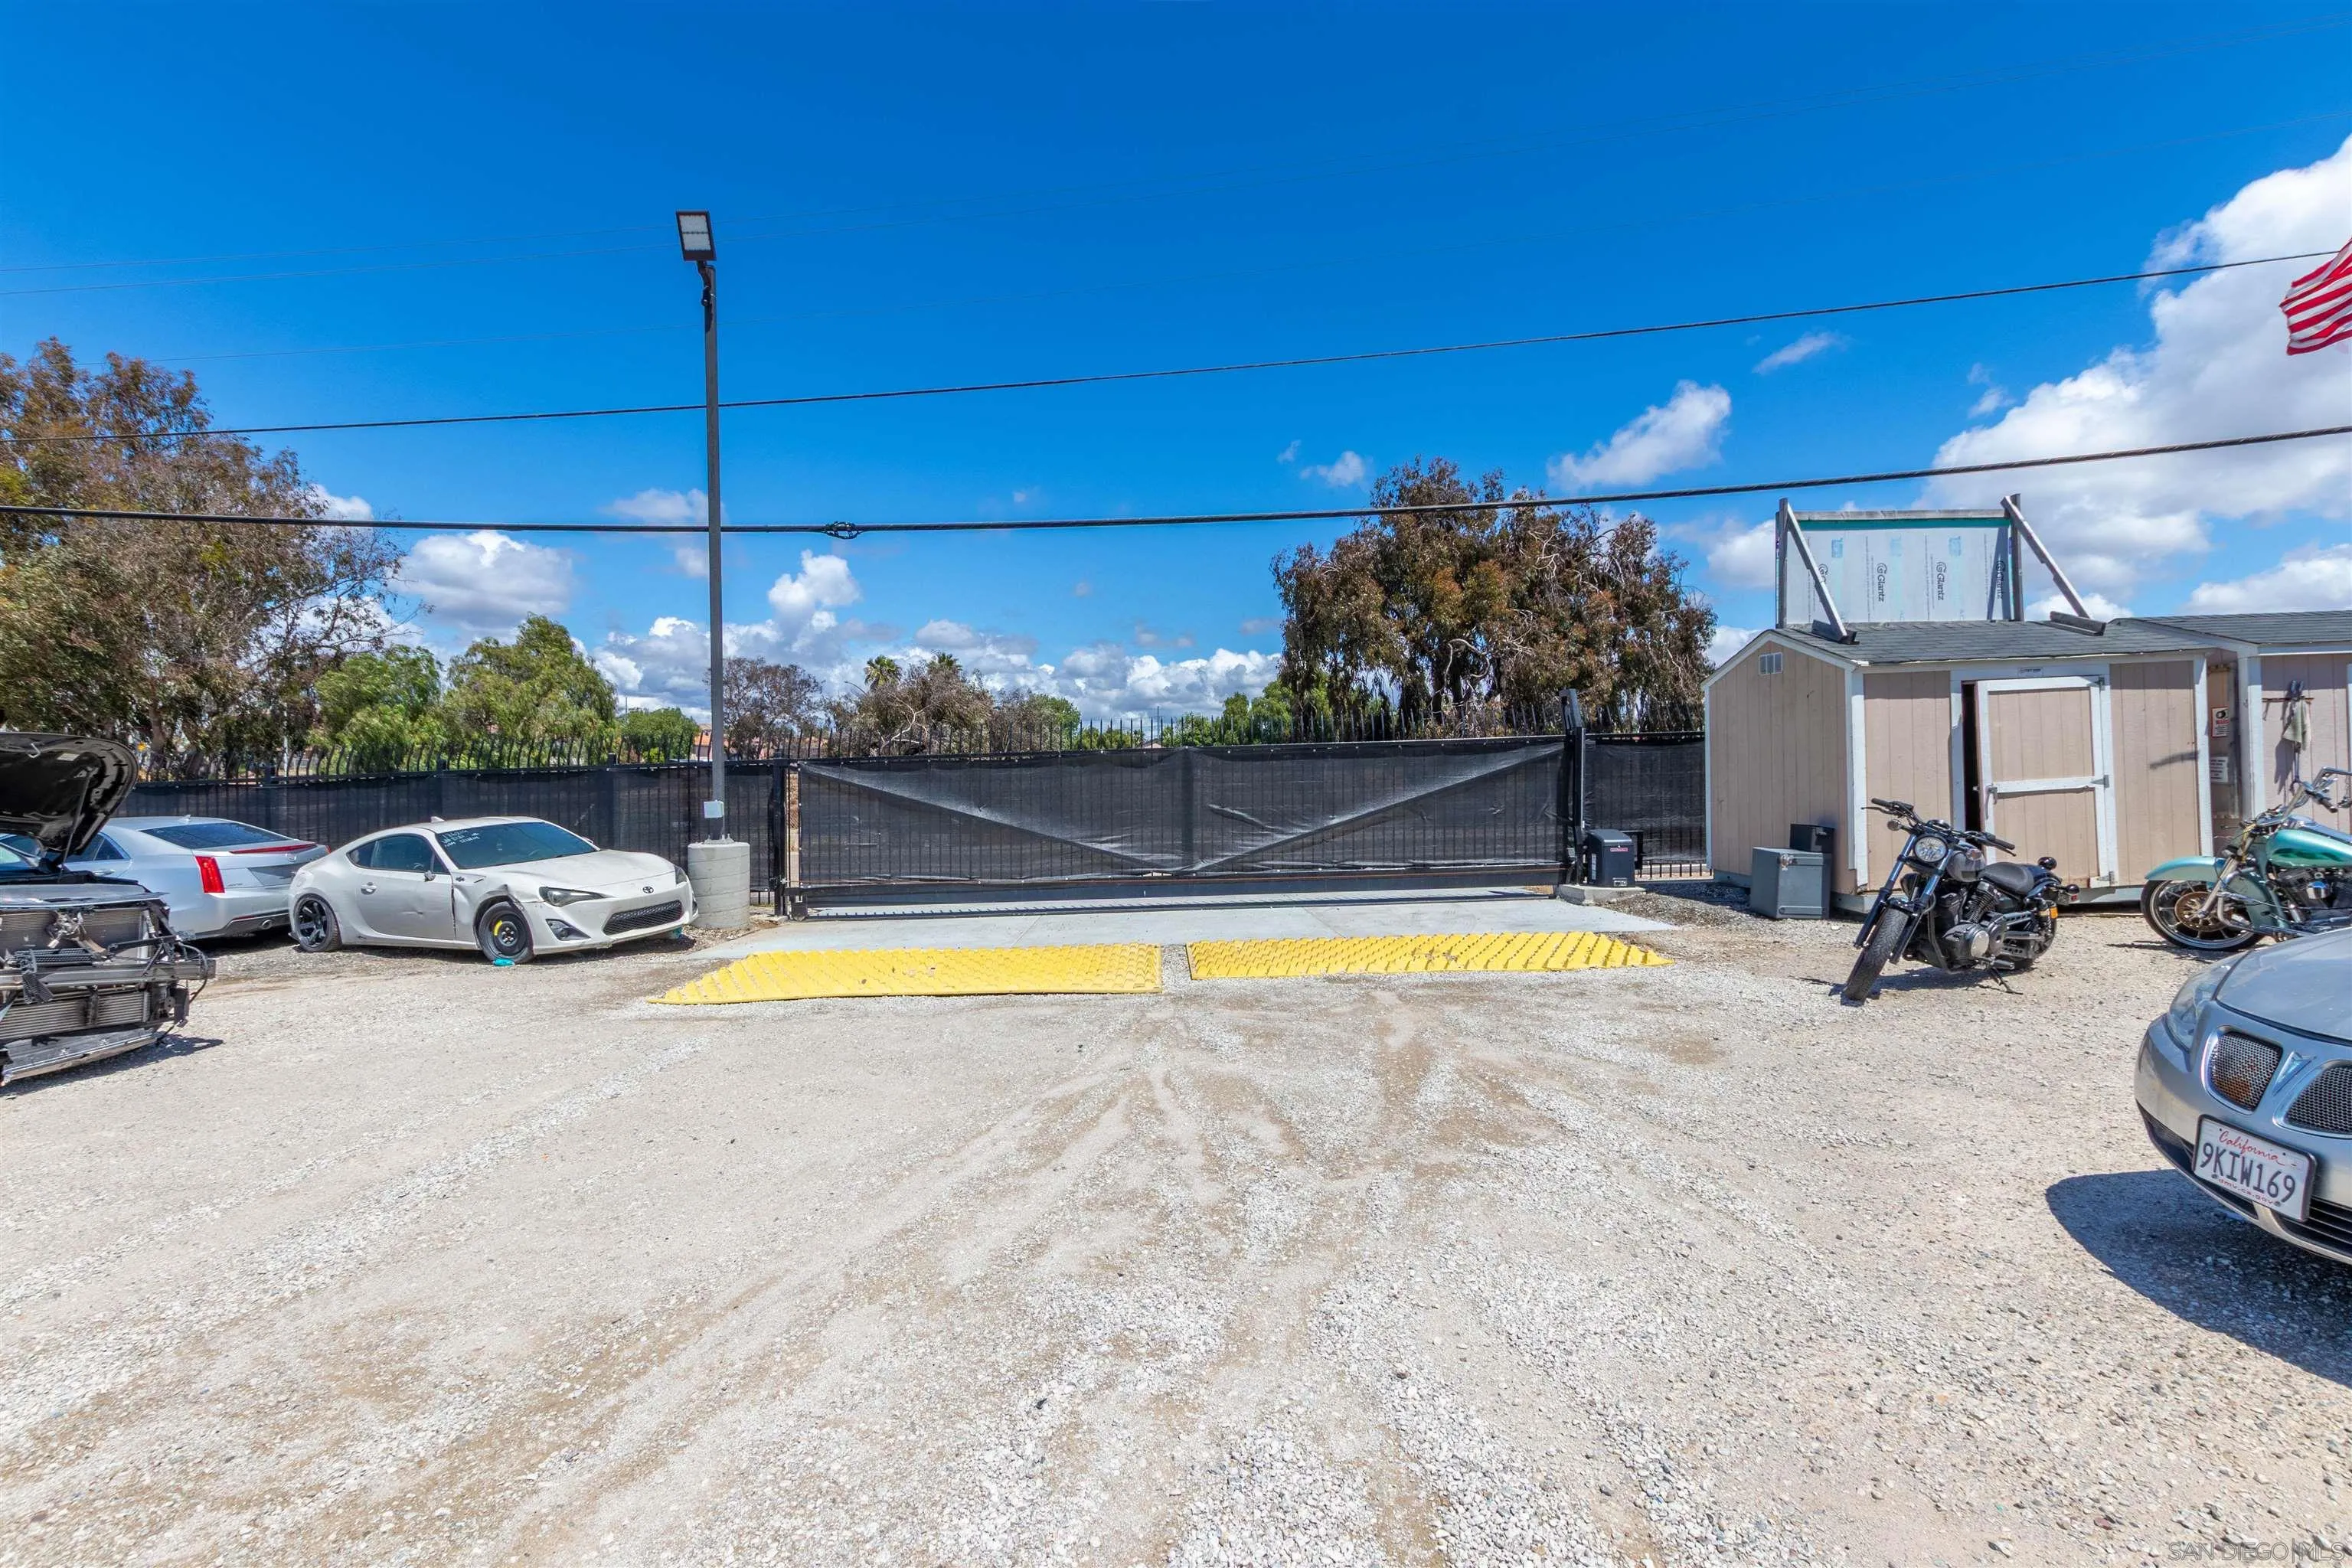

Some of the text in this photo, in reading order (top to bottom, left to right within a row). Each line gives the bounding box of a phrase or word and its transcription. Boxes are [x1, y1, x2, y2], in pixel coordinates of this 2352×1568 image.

[1877, 574, 1886, 603] Glantz
[1936, 573, 1945, 601] Glantz
[2219, 1130, 2285, 1166] California
[2200, 1142, 2295, 1203] 9KIW169
[2219, 1179, 2273, 1204] dmv.ca.gov
